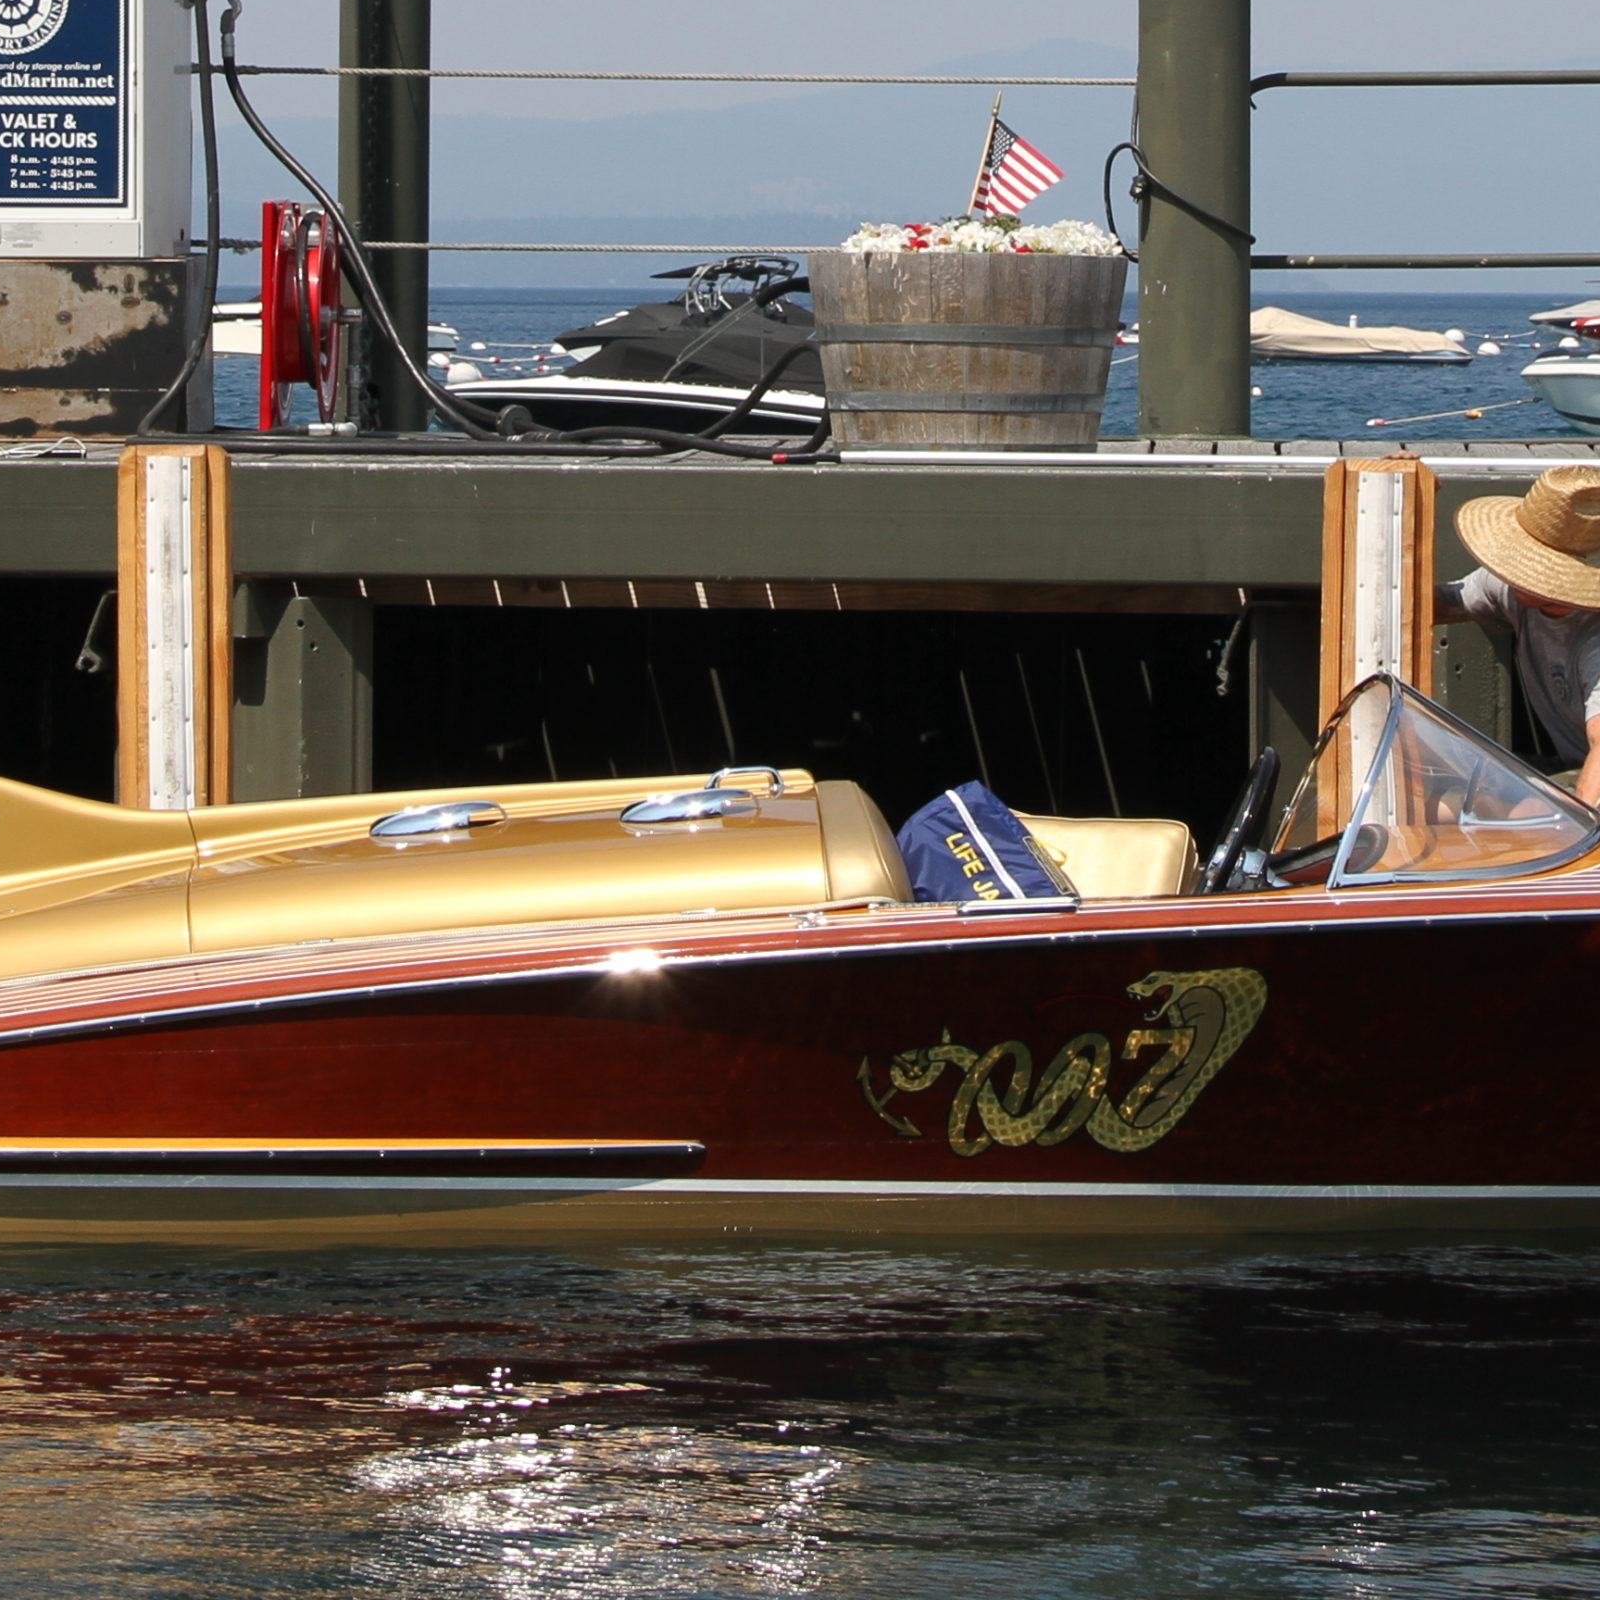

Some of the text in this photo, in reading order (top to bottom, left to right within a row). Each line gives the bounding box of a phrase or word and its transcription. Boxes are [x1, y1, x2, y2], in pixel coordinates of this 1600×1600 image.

[16, 61, 31, 72] dry
[31, 62, 62, 72] storage
[64, 61, 91, 71] online
[91, 62, 102, 71] at
[1, 113, 58, 129] VALET
[63, 114, 78, 130] &
[30, 132, 98, 149] HOURS
[10, 153, 18, 164] 8
[50, 156, 75, 166] 4:45
[75, 157, 97, 166] p.m.
[9, 168, 18, 178] 7
[19, 169, 41, 177] a.m.
[50, 168, 75, 179] 5:45
[75, 169, 97, 179] p.m.
[10, 179, 18, 189] 8
[19, 181, 41, 189] a.m.
[50, 181, 75, 191] 4:45
[75, 182, 97, 191] p.m.
[944, 832, 1001, 901] LIFE JA
